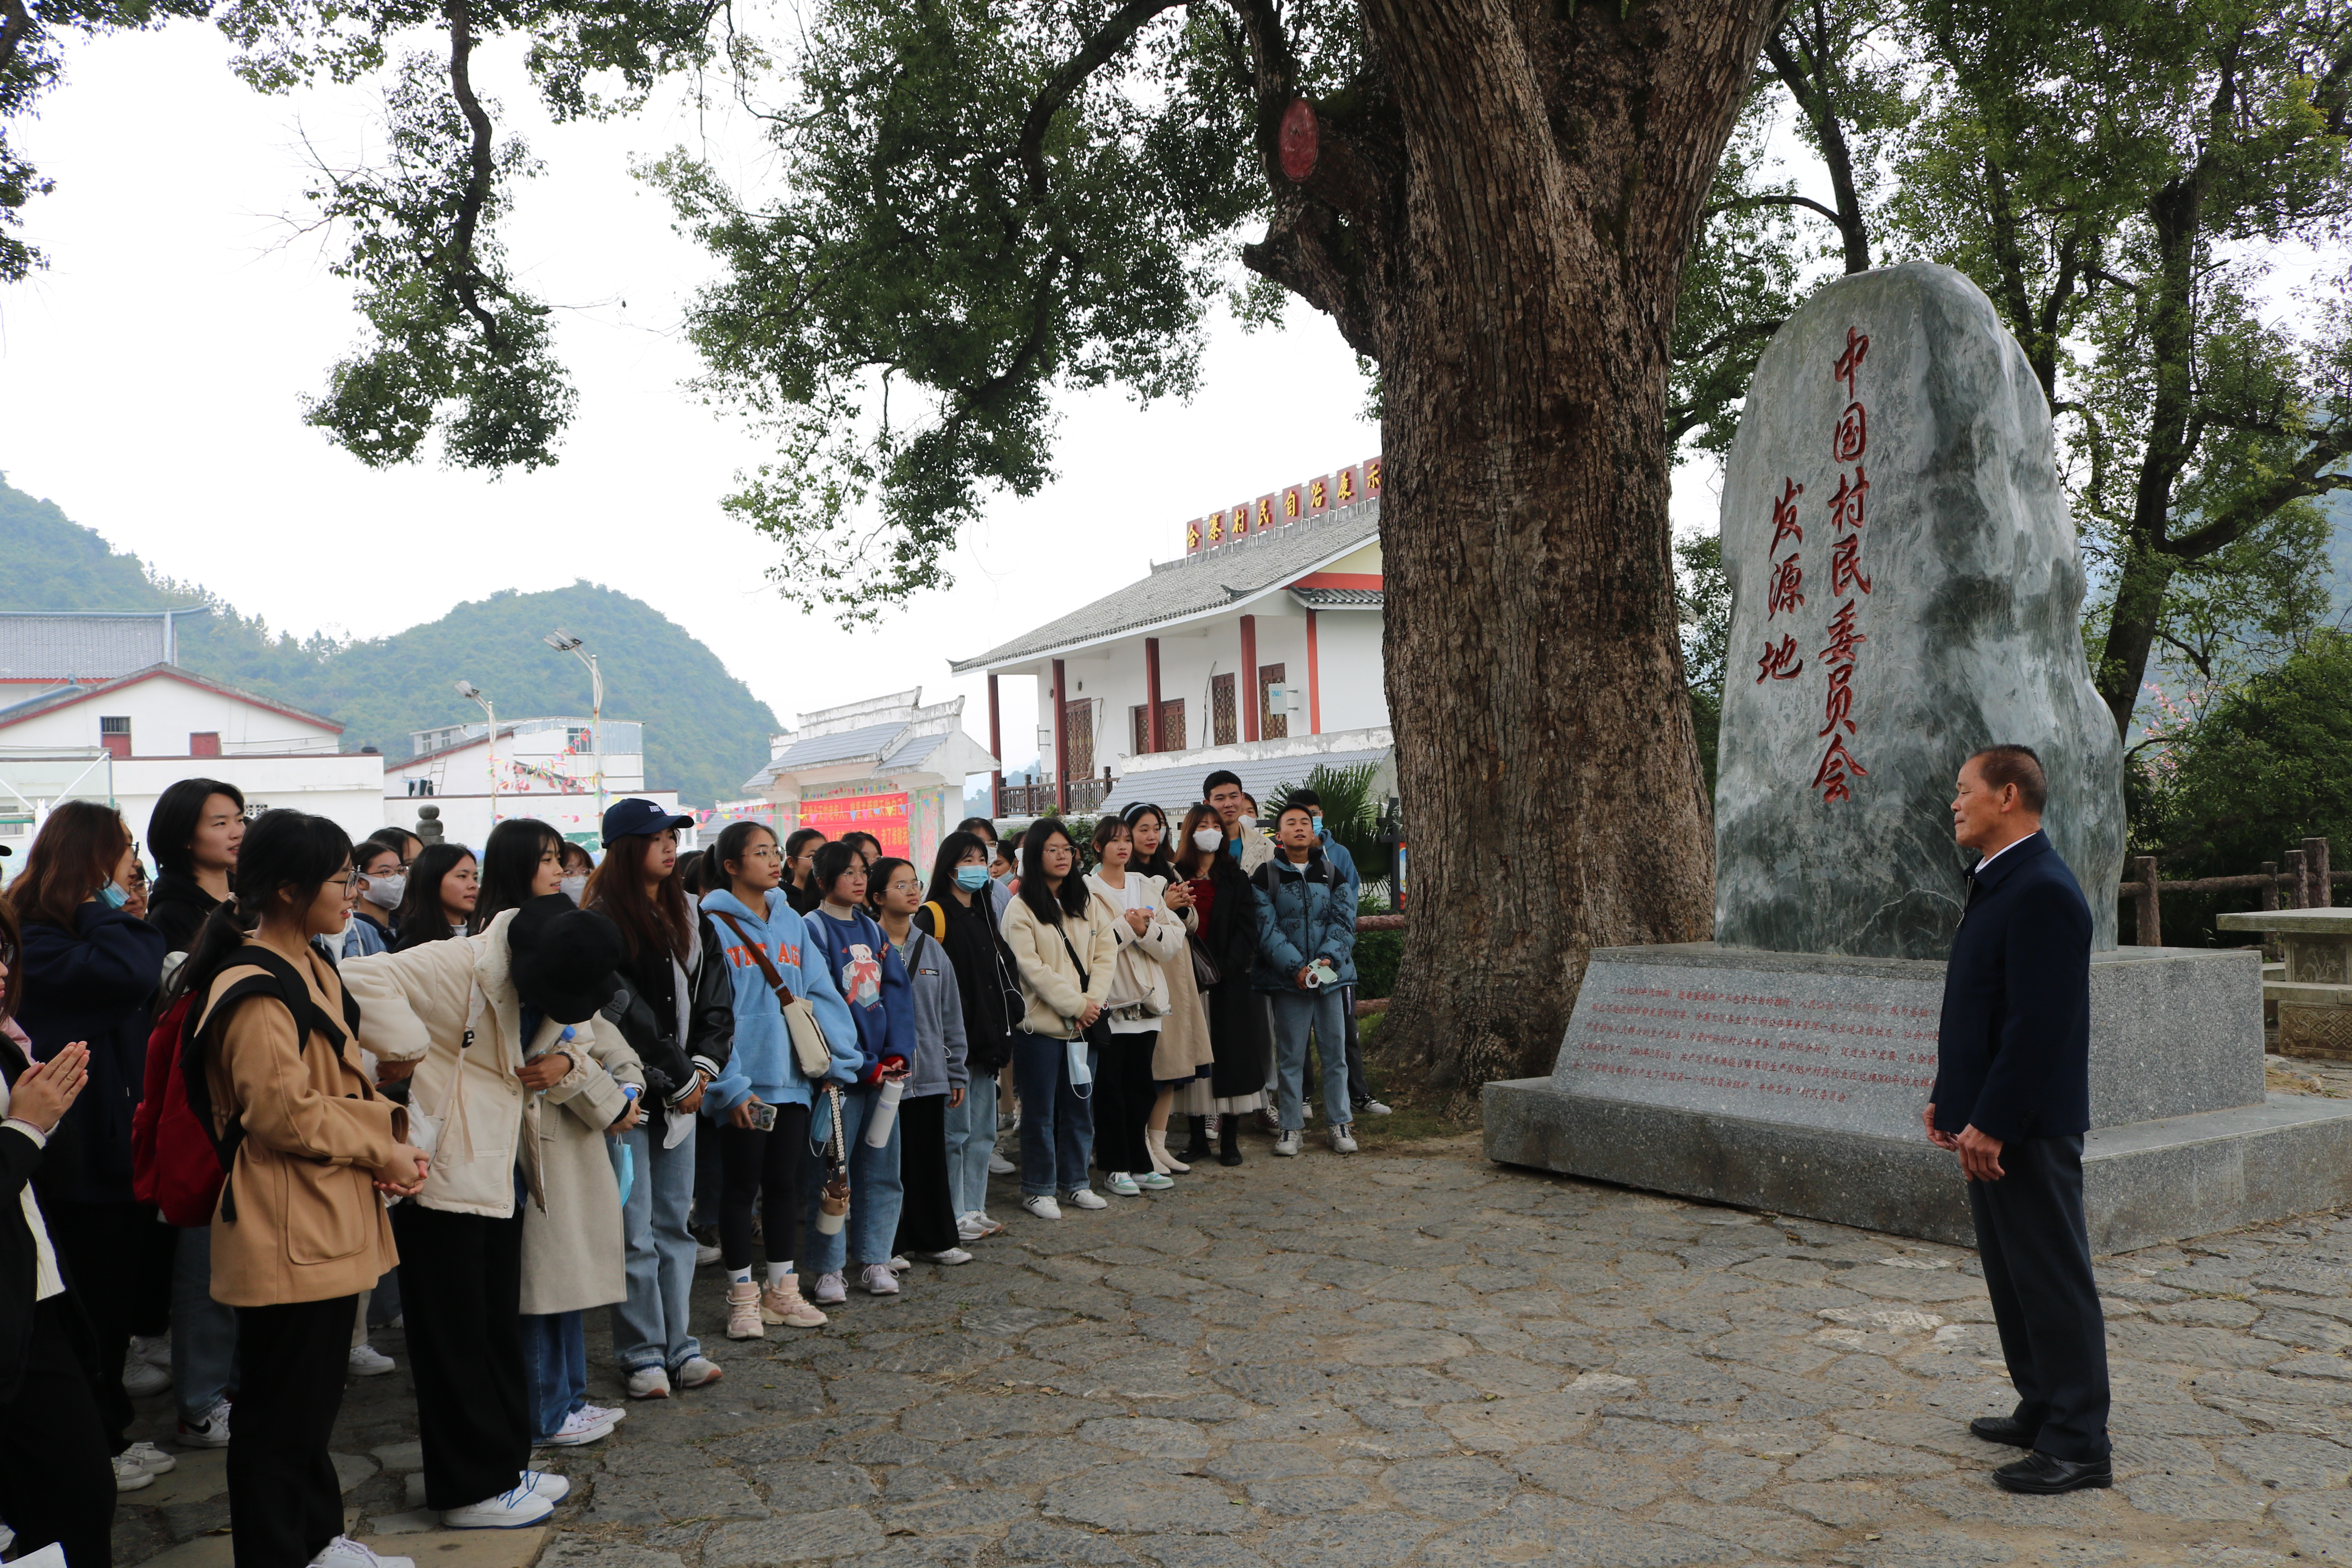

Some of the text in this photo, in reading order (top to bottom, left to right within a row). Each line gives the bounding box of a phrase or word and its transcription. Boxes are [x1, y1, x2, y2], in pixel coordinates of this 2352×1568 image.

[1186, 464, 1379, 548] 合寨村民自治展示
[1756, 477, 1805, 685] 发源地
[1812, 326, 1872, 804] 中国村民委员会
